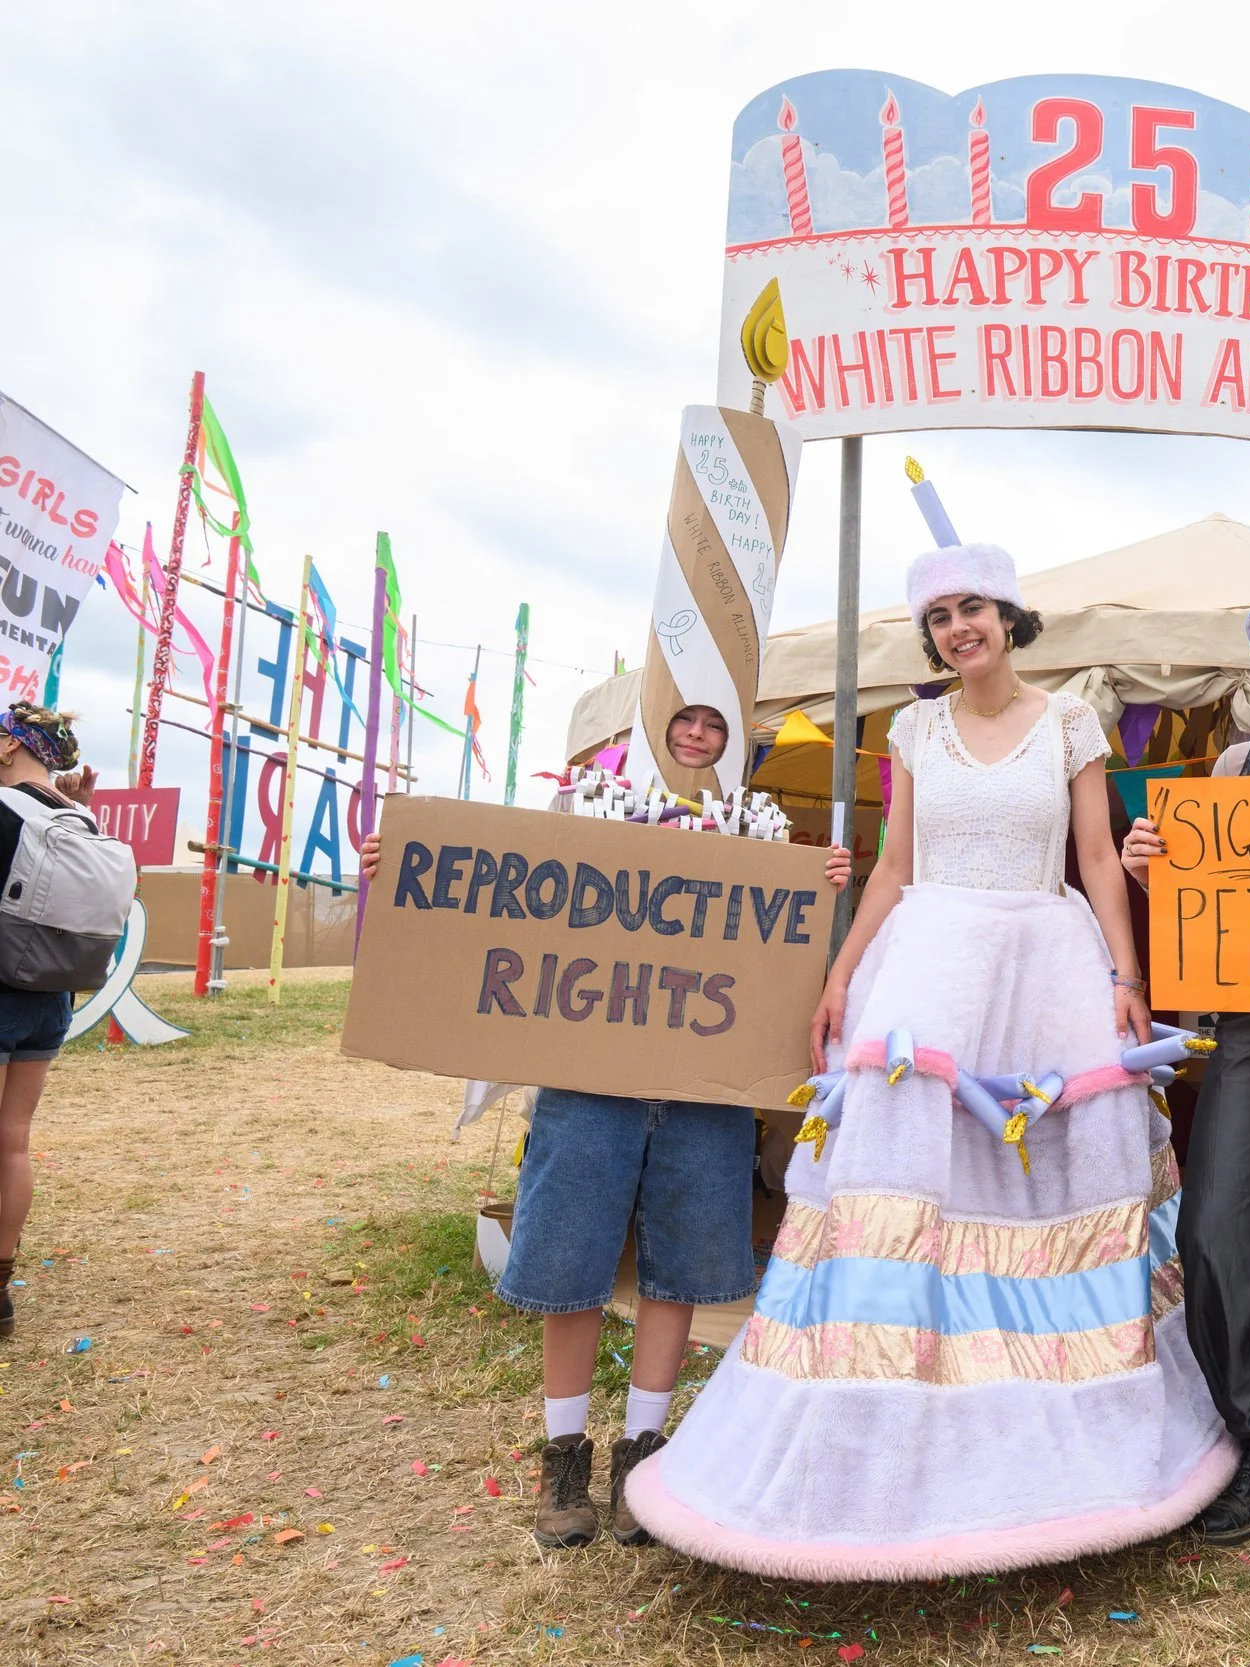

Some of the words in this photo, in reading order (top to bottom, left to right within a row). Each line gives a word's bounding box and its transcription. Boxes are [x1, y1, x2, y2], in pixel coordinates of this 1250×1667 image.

[1025, 96, 1198, 239] 25
[880, 246, 1099, 313] HAPPY
[776, 323, 962, 417] WHITE
[976, 323, 1184, 406] RIBBON
[691, 432, 725, 450] HAPPY
[695, 449, 748, 494] 25th
[0, 455, 99, 539] GIRLS
[710, 489, 751, 511] BIRTH
[5, 519, 60, 562] wanna
[731, 532, 773, 561] HAPPY
[684, 511, 712, 557] WHITE
[708, 561, 736, 606] RIBBON
[731, 612, 754, 666] ALLIANCE
[393, 840, 818, 945] REPRODUCTIVE
[476, 947, 737, 1038] RIGHTS
